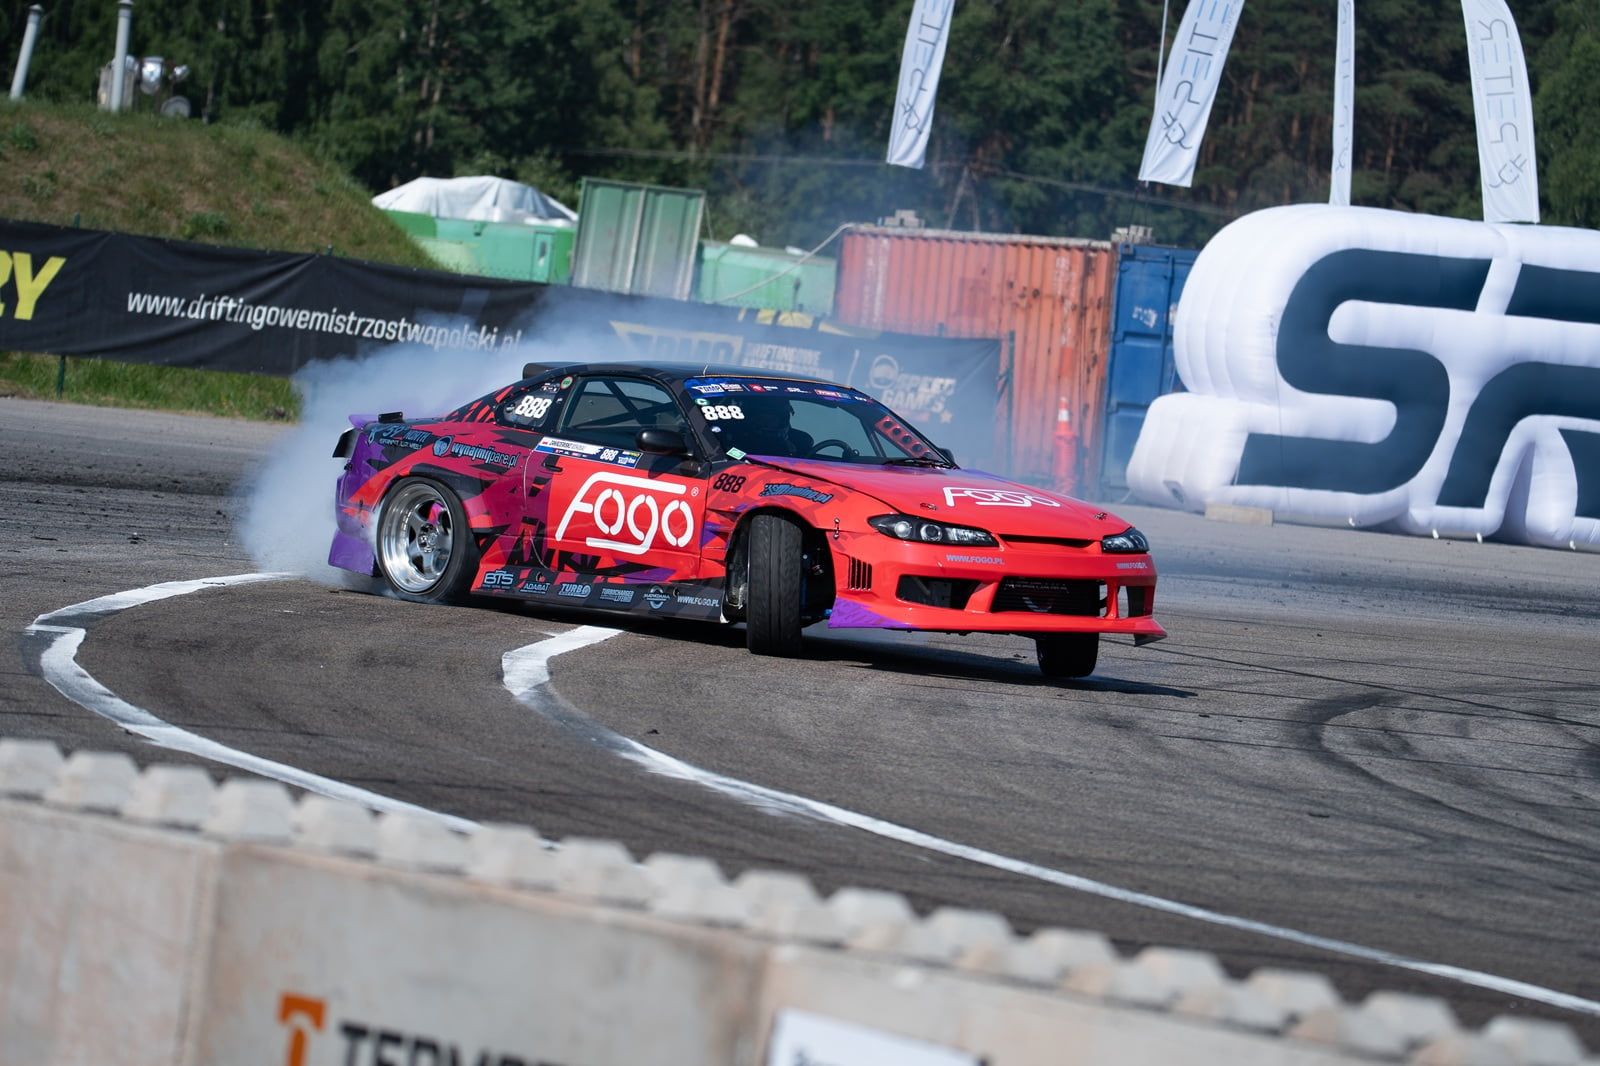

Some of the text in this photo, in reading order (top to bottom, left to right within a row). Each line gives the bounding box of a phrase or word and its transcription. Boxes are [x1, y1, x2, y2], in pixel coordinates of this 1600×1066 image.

[515, 395, 552, 419] 888
[701, 405, 745, 421] 888
[600, 448, 618, 461] 888
[713, 473, 747, 493] 888
[946, 554, 1006, 566] WWW.FOGO.PL
[483, 571, 514, 586] BTS
